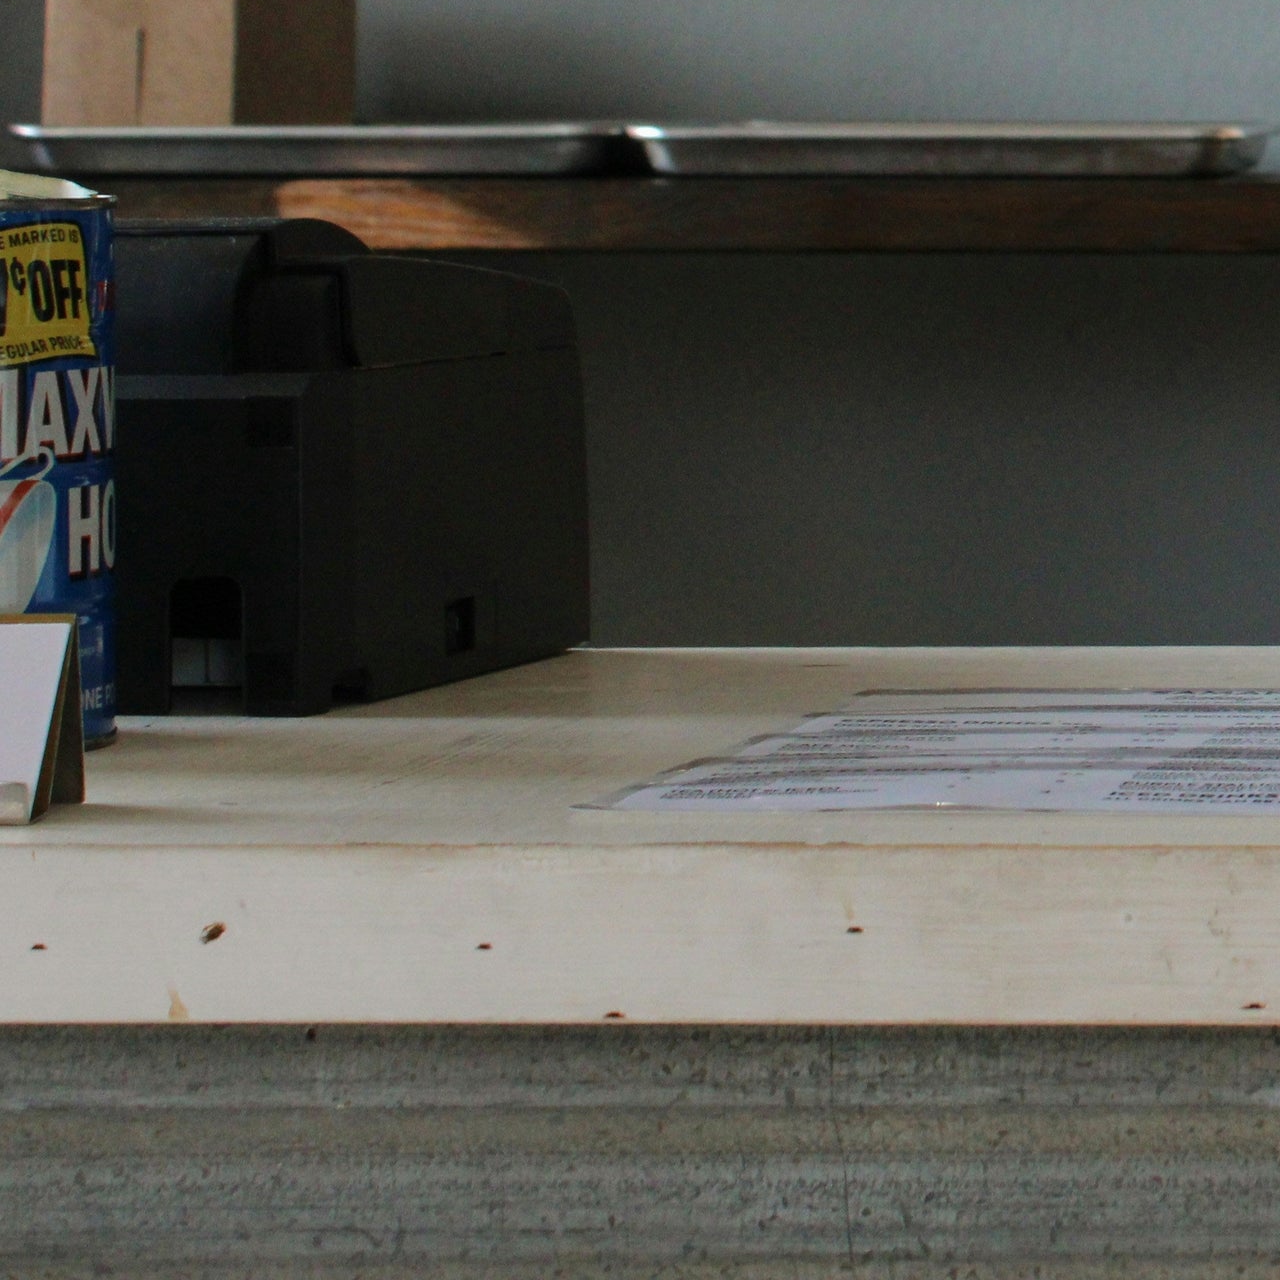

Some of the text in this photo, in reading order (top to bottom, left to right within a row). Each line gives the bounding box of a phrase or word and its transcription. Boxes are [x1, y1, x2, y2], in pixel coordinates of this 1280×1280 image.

[8, 228, 66, 247] MARKED
[70, 228, 80, 243] IS
[27, 259, 82, 322] OFF
